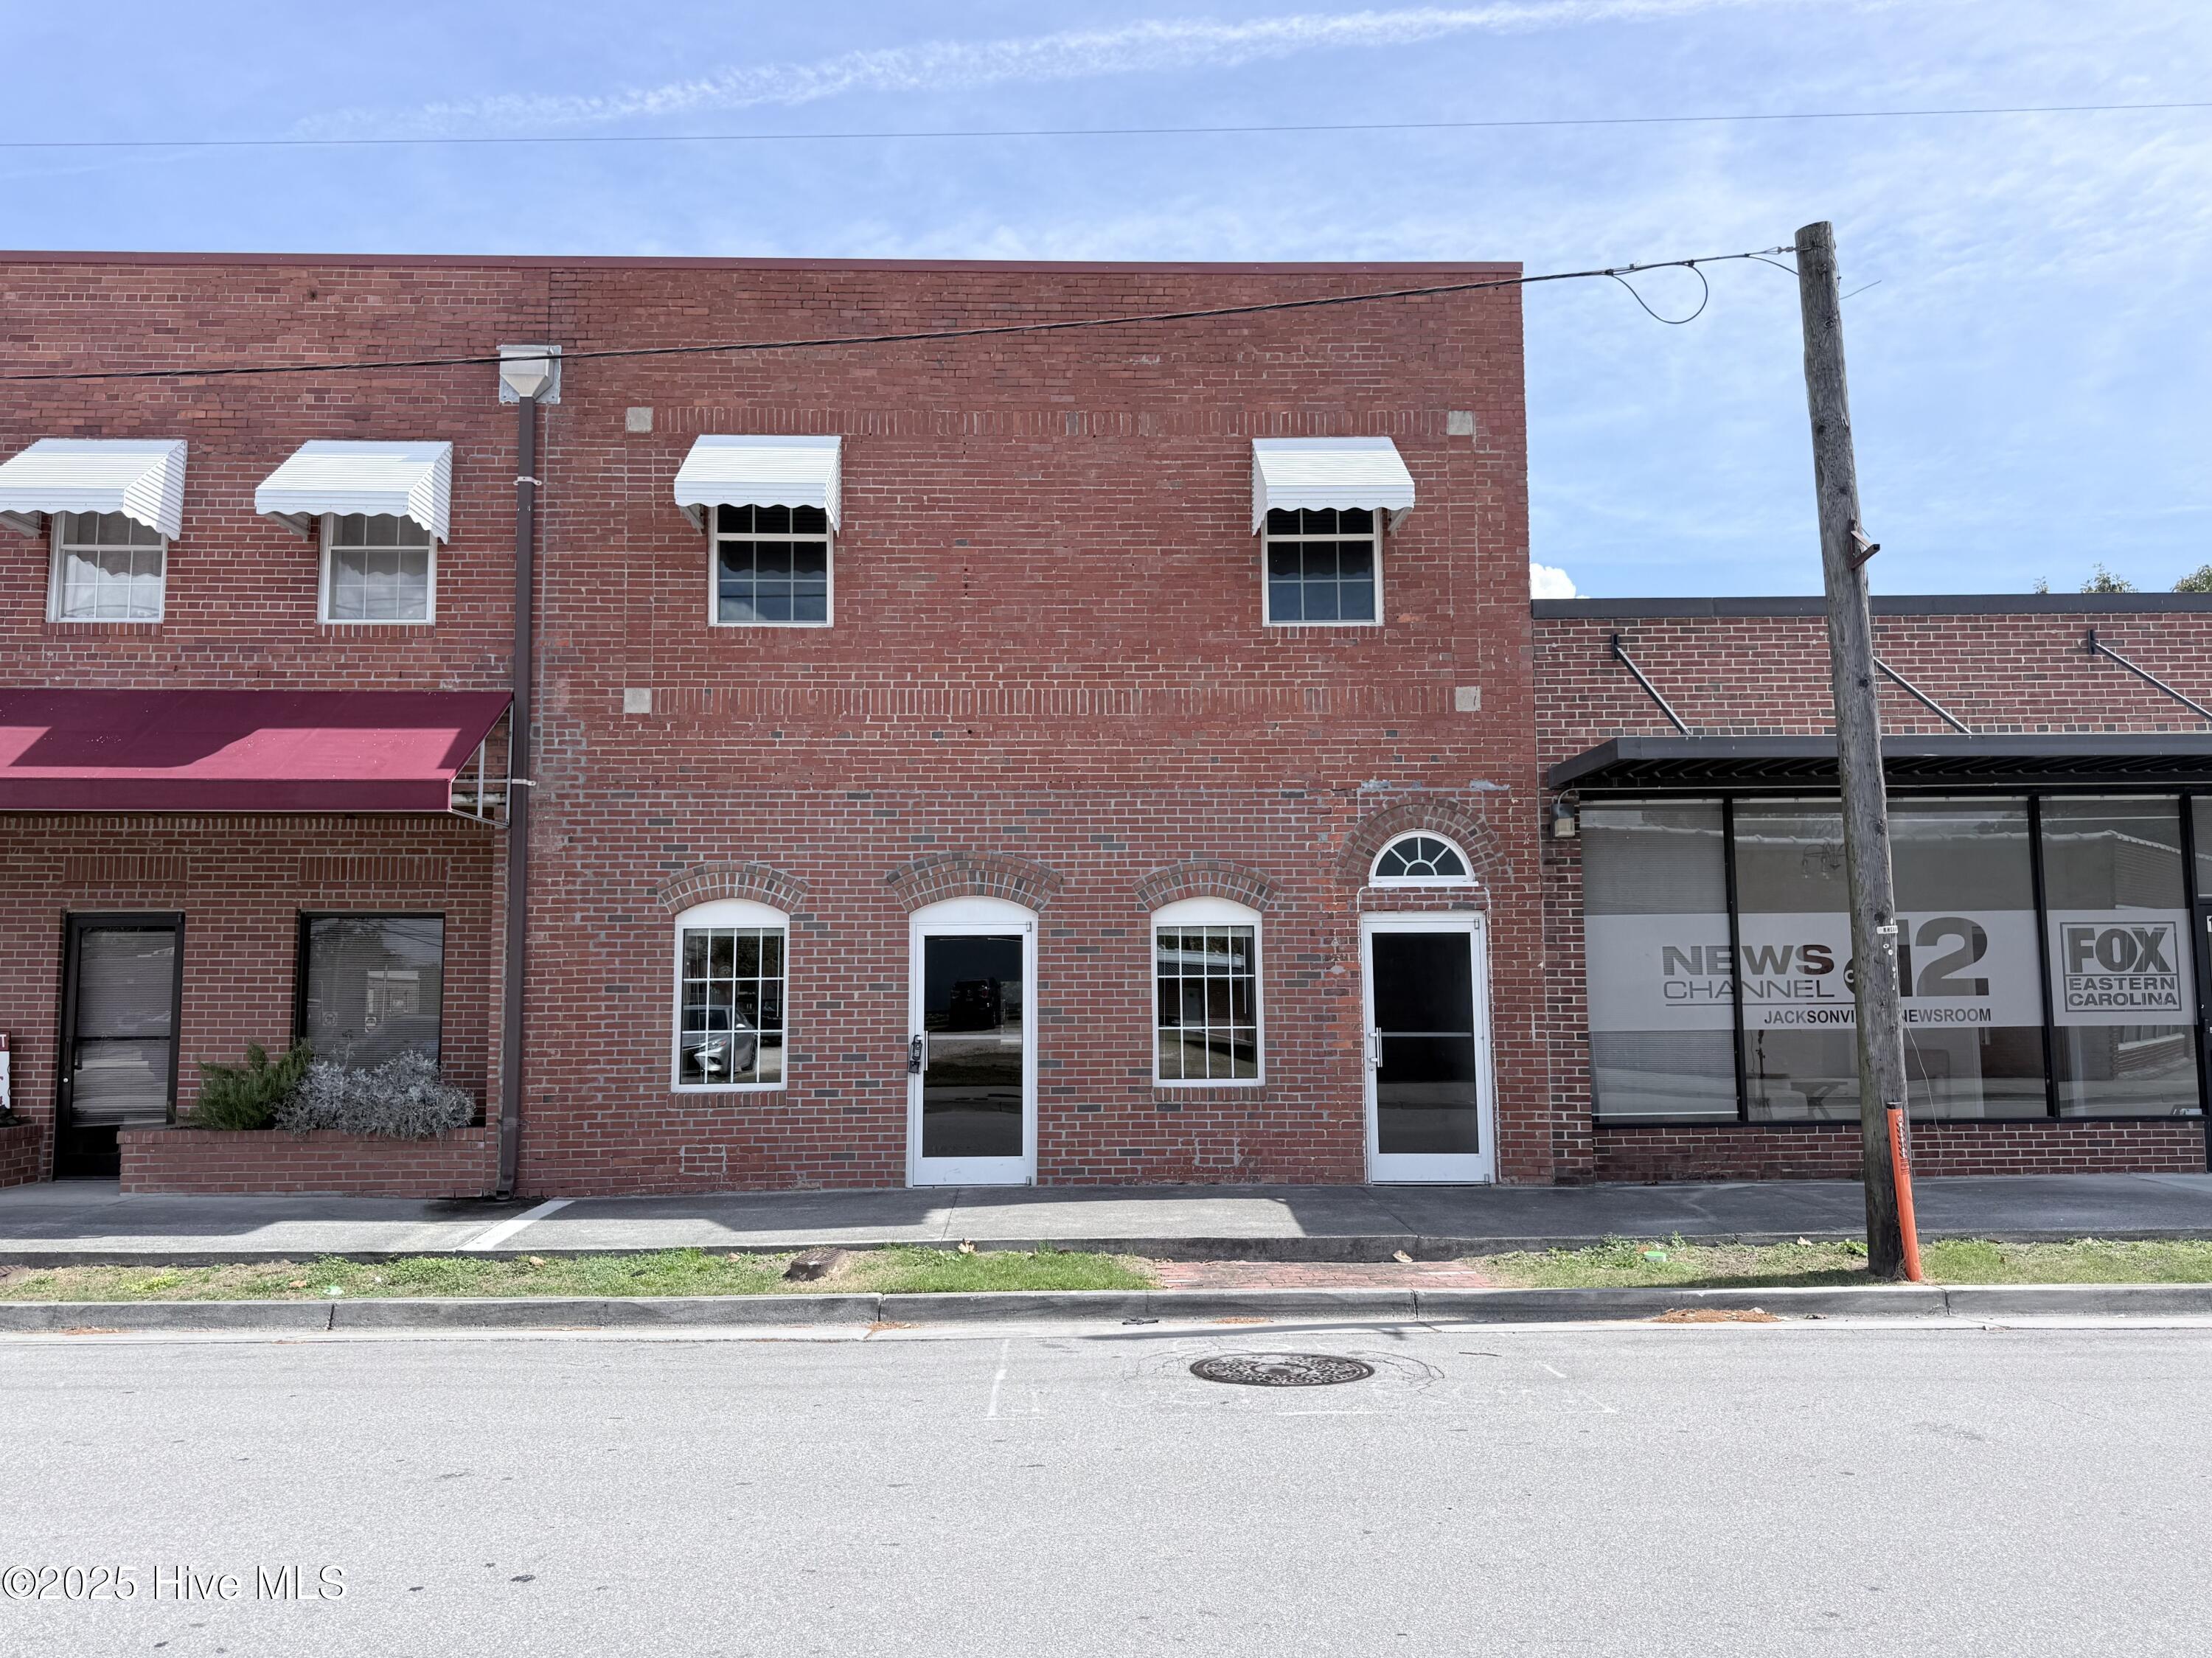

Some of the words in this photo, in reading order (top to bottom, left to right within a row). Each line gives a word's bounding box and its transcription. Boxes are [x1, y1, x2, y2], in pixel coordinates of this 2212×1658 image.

[2067, 927, 2172, 973] FOX
[1662, 944, 1834, 975] NEWS
[1663, 980, 1835, 999] CHANNEL
[2068, 977, 2175, 991] EASTERN
[2068, 992, 2177, 1007] CAROLINA
[1764, 1010, 1855, 1024] JACKSONVI
